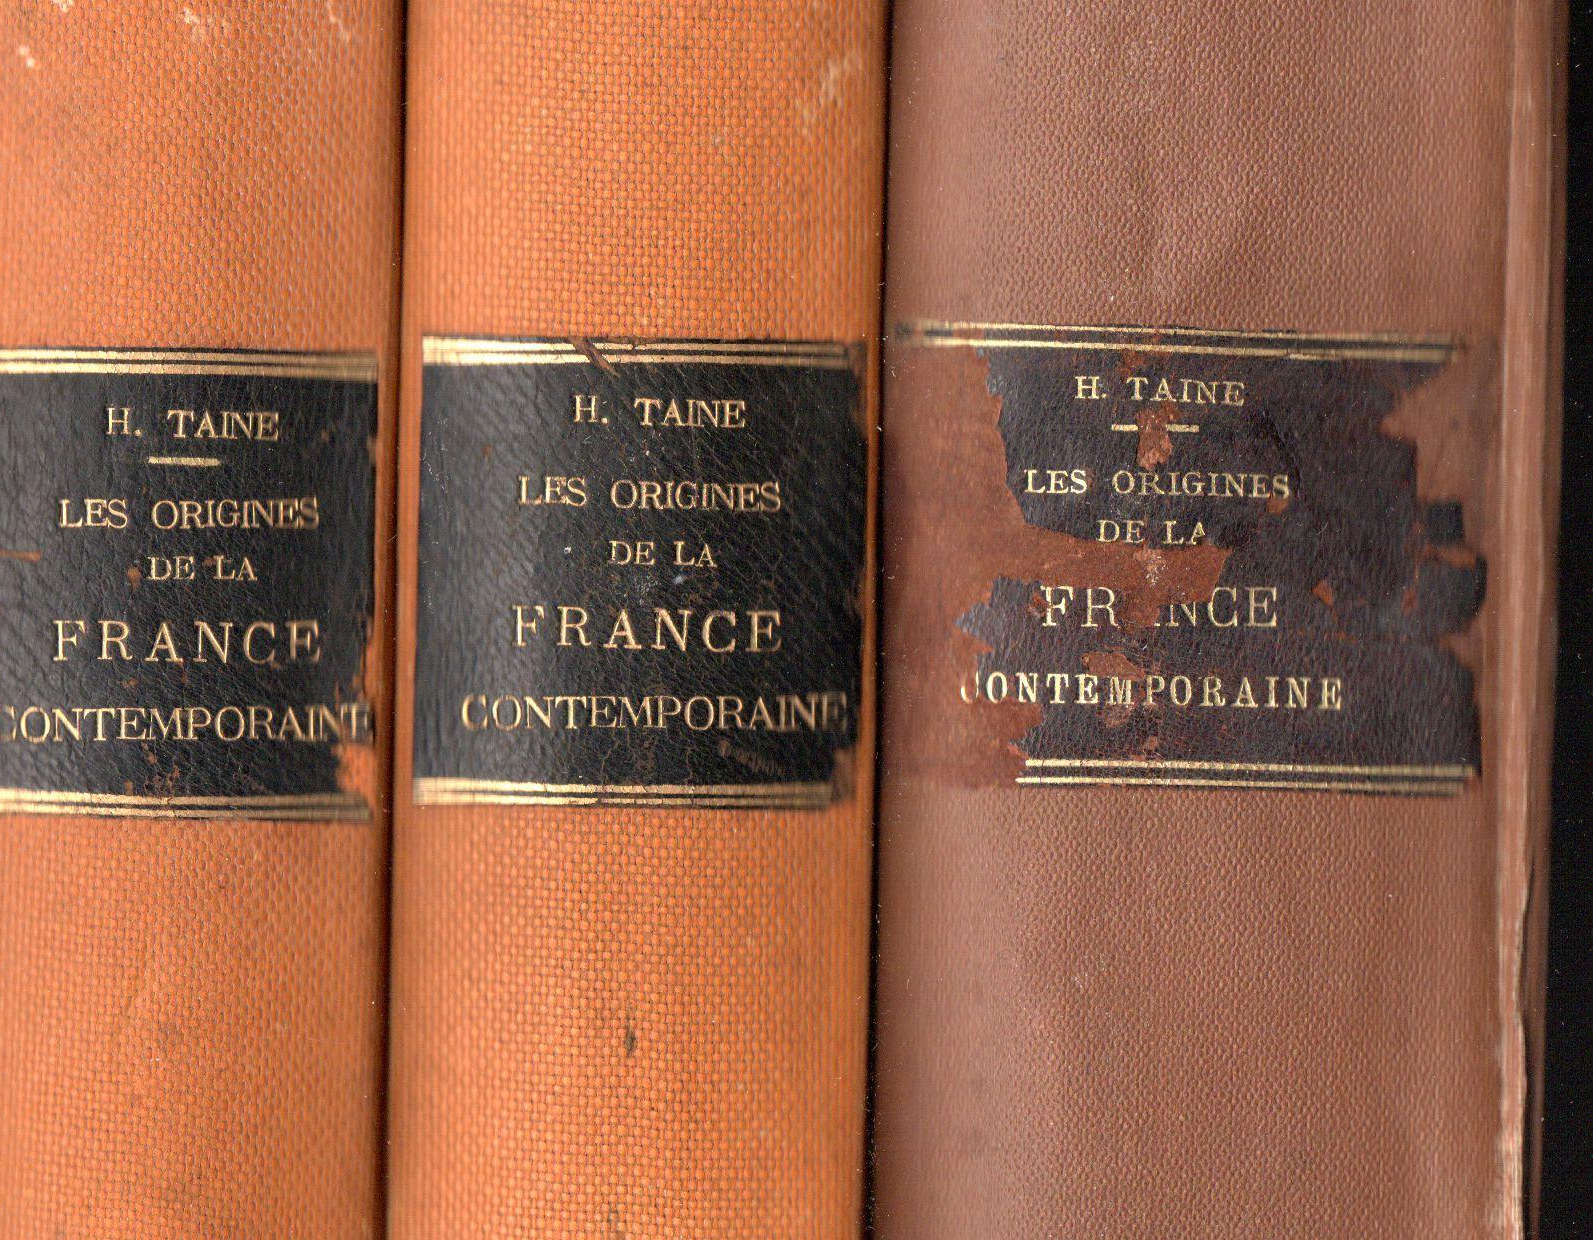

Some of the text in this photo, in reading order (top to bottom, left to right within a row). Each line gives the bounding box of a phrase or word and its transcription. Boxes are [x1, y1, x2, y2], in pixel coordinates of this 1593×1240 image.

[1074, 376, 1245, 407] H. TAINE
[106, 407, 279, 441] H. TAINE
[573, 394, 746, 428] H. TAINE
[518, 476, 781, 513] LES ORIGINES
[1024, 469, 1290, 499] LES ORIGINES
[60, 496, 320, 530] LES ORIGINES
[1096, 520, 1206, 545] DE LA
[147, 556, 257, 581] DE LA
[610, 540, 717, 567] DE LA
[1040, 586, 1278, 628] FRNCE
[53, 620, 321, 664] FRANCE
[512, 605, 782, 652] FRANCE
[460, 692, 847, 733] CONTEMPORAINE
